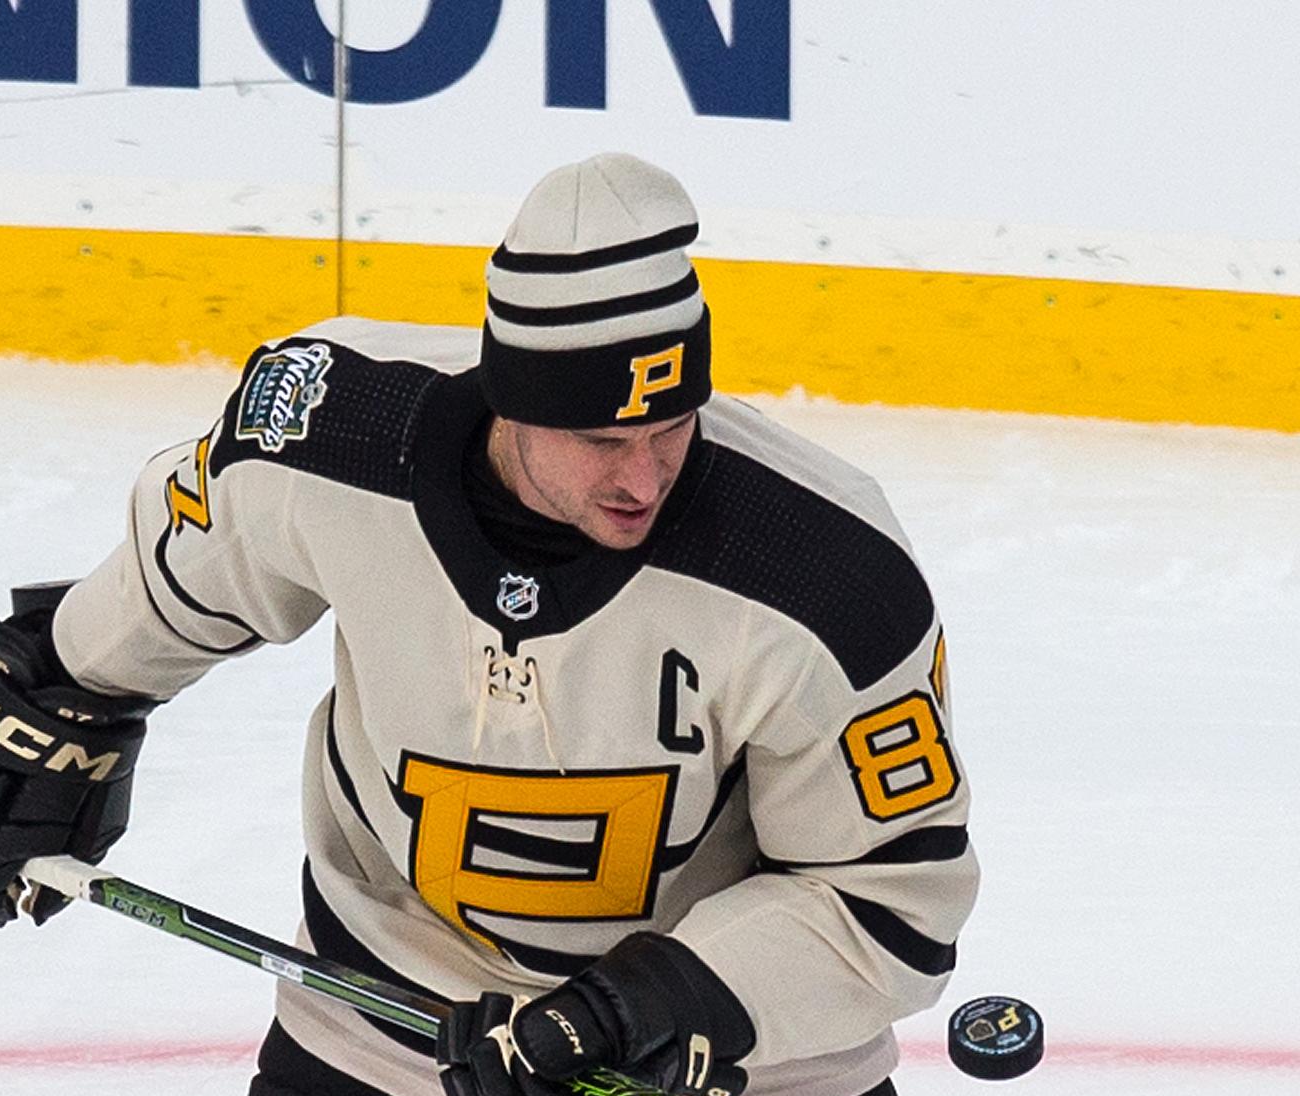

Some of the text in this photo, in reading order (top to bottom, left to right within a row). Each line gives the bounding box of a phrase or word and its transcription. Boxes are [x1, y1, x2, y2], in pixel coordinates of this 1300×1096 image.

[263, 346, 328, 446] Winter
[615, 342, 685, 420] P
[657, 647, 705, 755] C
[838, 623, 962, 823] 8
[397, 748, 681, 958] P
[112, 896, 166, 928] CCM
[545, 1009, 584, 1055] CCM
